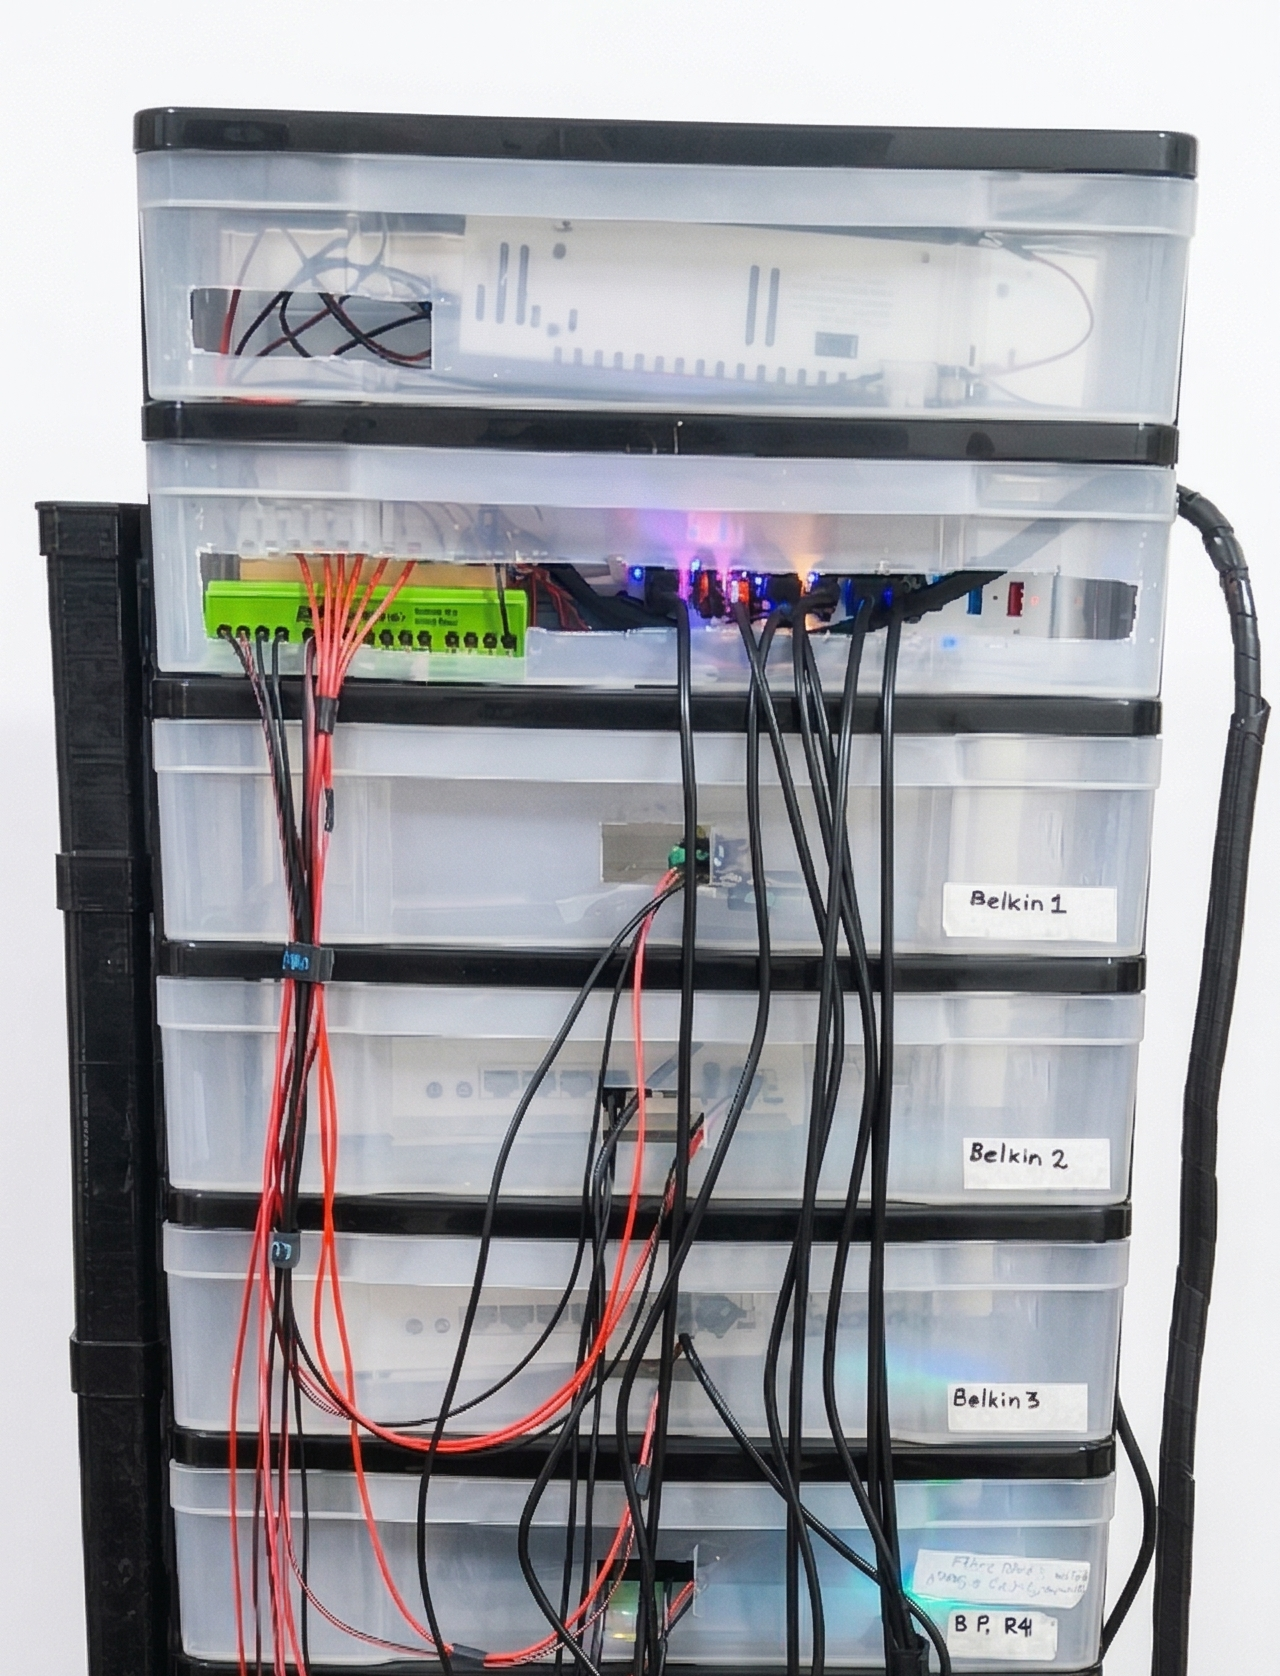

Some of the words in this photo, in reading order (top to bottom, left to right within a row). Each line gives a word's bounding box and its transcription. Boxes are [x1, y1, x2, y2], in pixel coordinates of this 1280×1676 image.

[970, 891, 1044, 911] Belkin
[1051, 894, 1067, 914] 1
[970, 1142, 1042, 1166] Belkin
[1052, 1149, 1068, 1169] 2
[953, 1387, 1020, 1409] Belkin
[1026, 1391, 1040, 1409] 3
[955, 1614, 968, 1632] B
